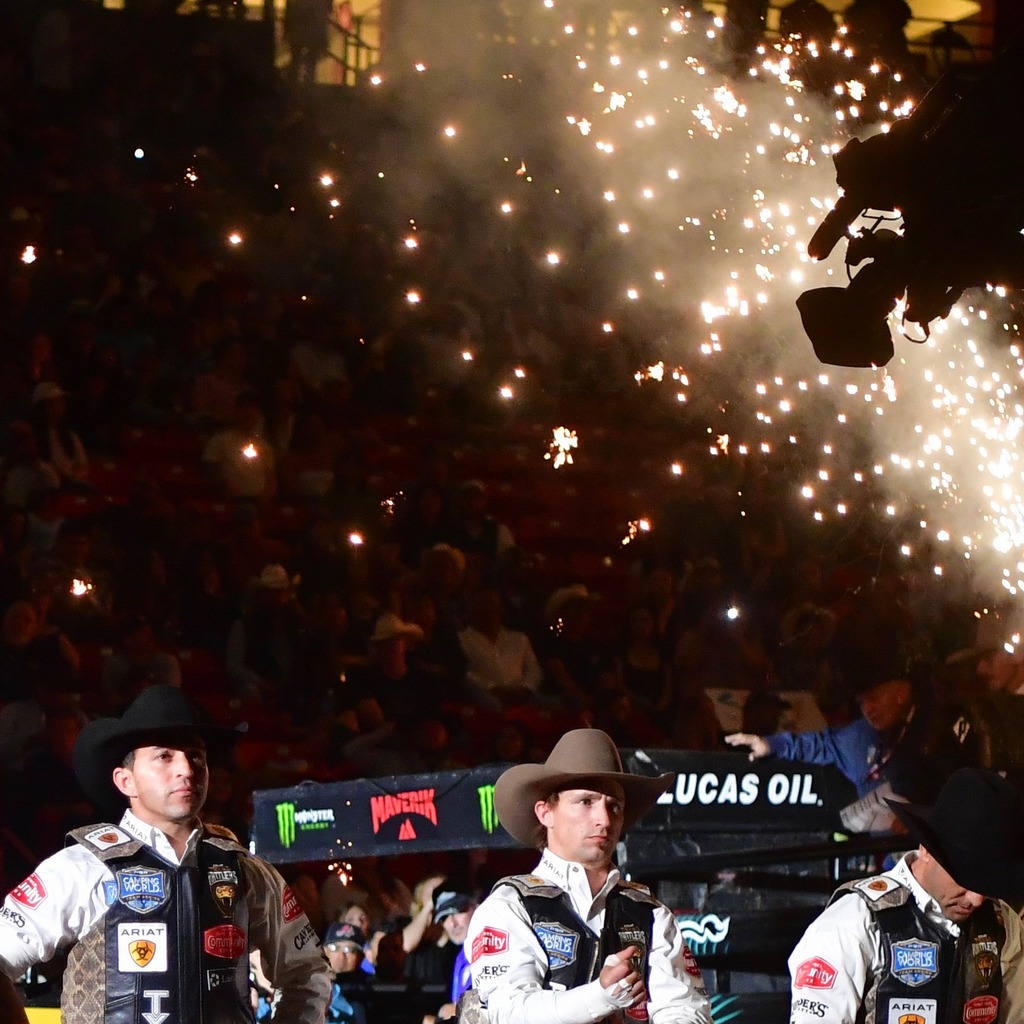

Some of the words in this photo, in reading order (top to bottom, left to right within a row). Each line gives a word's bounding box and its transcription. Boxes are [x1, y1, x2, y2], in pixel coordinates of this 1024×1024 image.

[370, 788, 438, 834] MAVERIK
[294, 809, 335, 824] MONSTER
[126, 820, 147, 842] ARIAT
[123, 877, 160, 885] CAMPING
[123, 883, 160, 892] WORLD
[121, 928, 164, 936] ARIAT
[537, 931, 573, 946] CAMPING
[897, 951, 933, 960] CAMPING
[898, 957, 932, 966] WORLD
[891, 1003, 934, 1011] ARIAT
